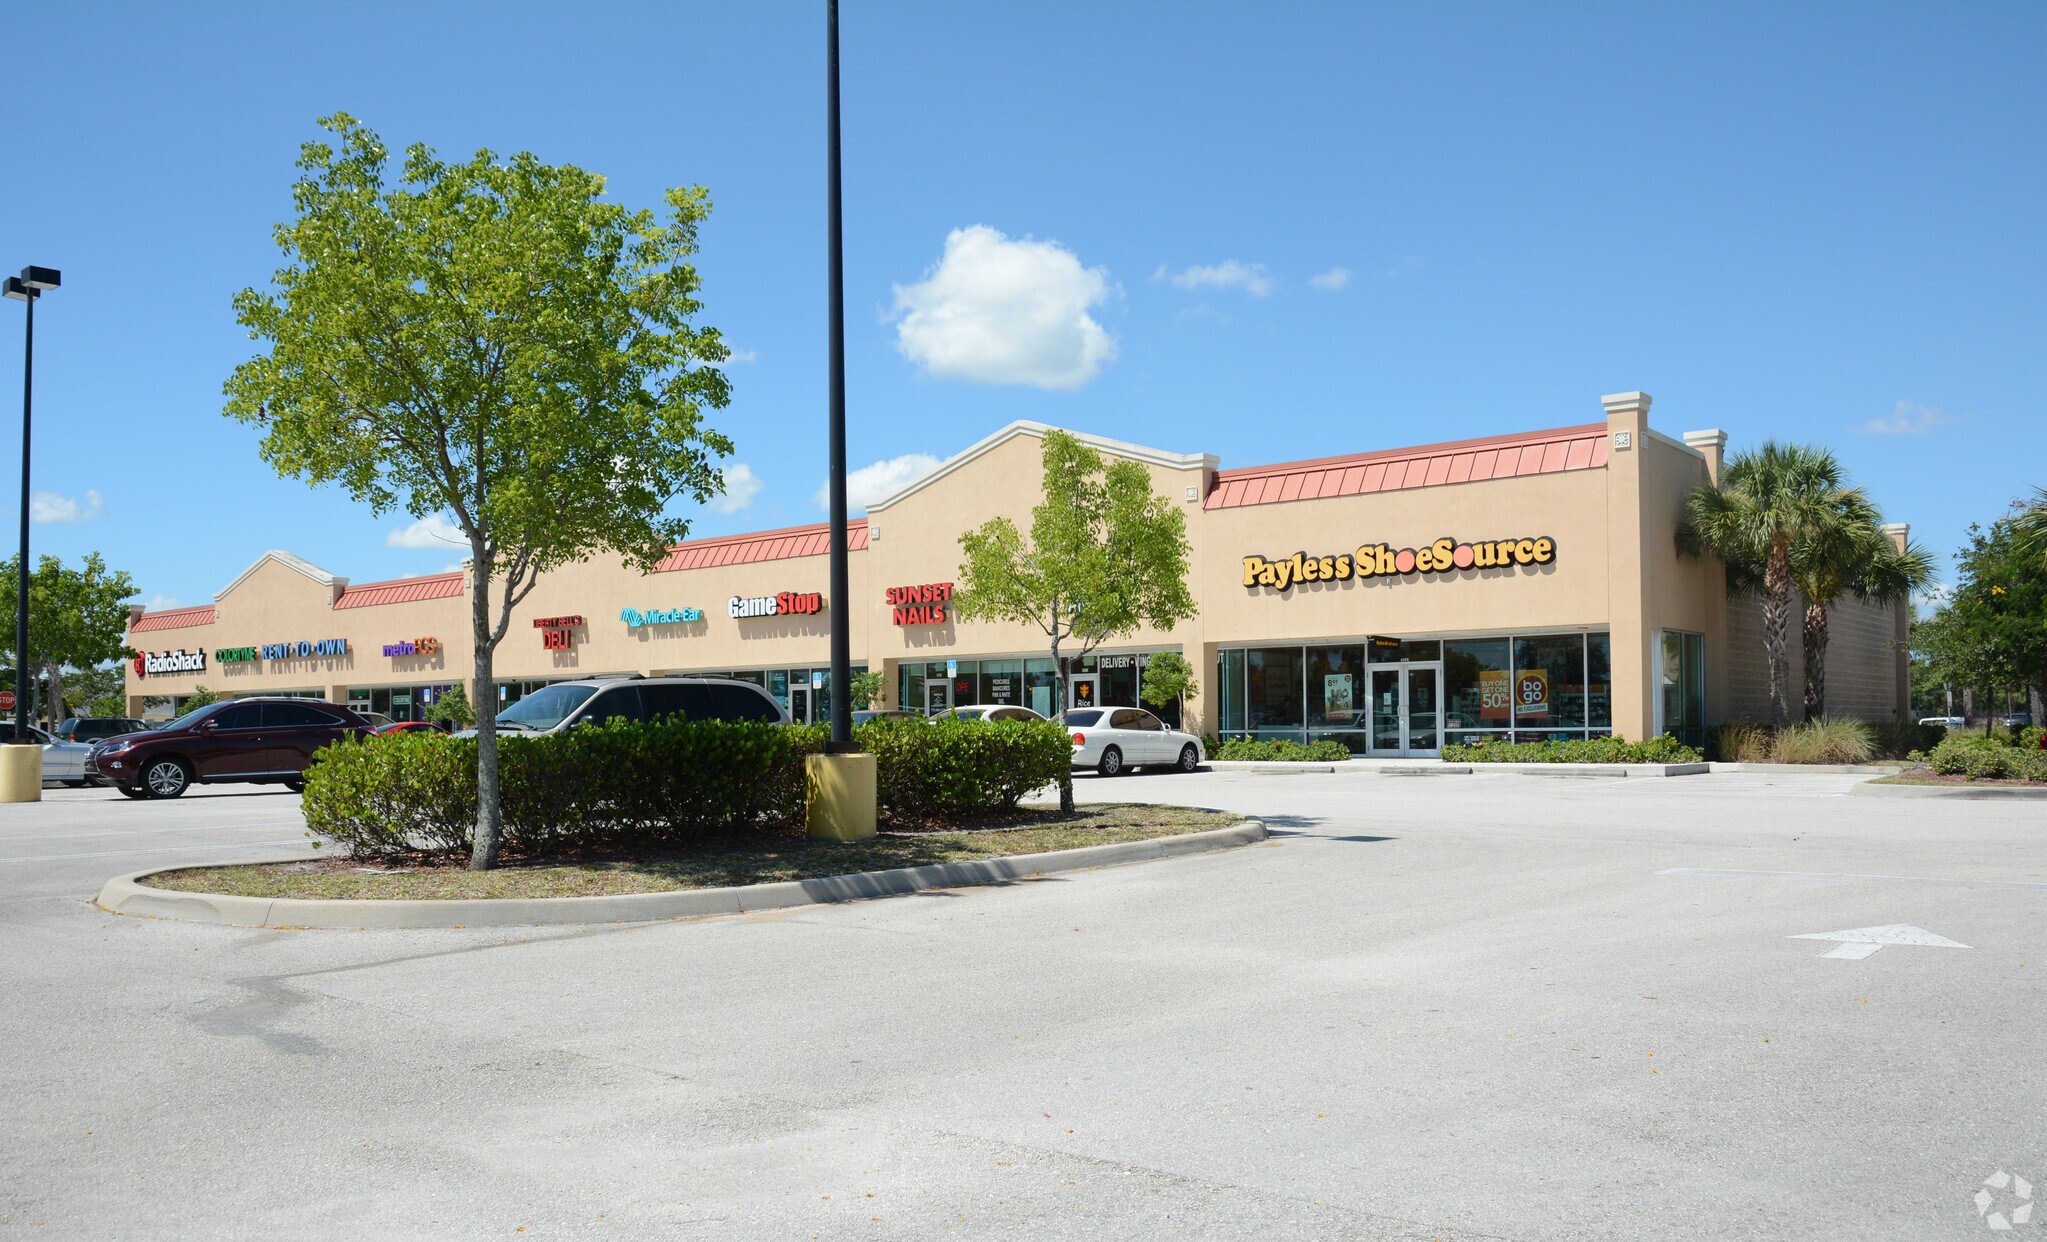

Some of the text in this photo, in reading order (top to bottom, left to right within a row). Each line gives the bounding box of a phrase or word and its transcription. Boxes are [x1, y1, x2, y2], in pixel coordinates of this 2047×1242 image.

[1242, 537, 1554, 591] Payless ShoeSource
[885, 582, 953, 605] SUNSET
[727, 591, 821, 618] GameStop
[533, 618, 558, 628] LIBERTY
[893, 605, 946, 625] NAILS
[383, 637, 437, 657] metroPCS
[543, 630, 570, 650] DELI
[145, 649, 204, 673] RadioShack
[215, 647, 256, 663] COLORTYME
[1101, 657, 1130, 668] DELIVERY
[1077, 699, 1090, 708] Rice
